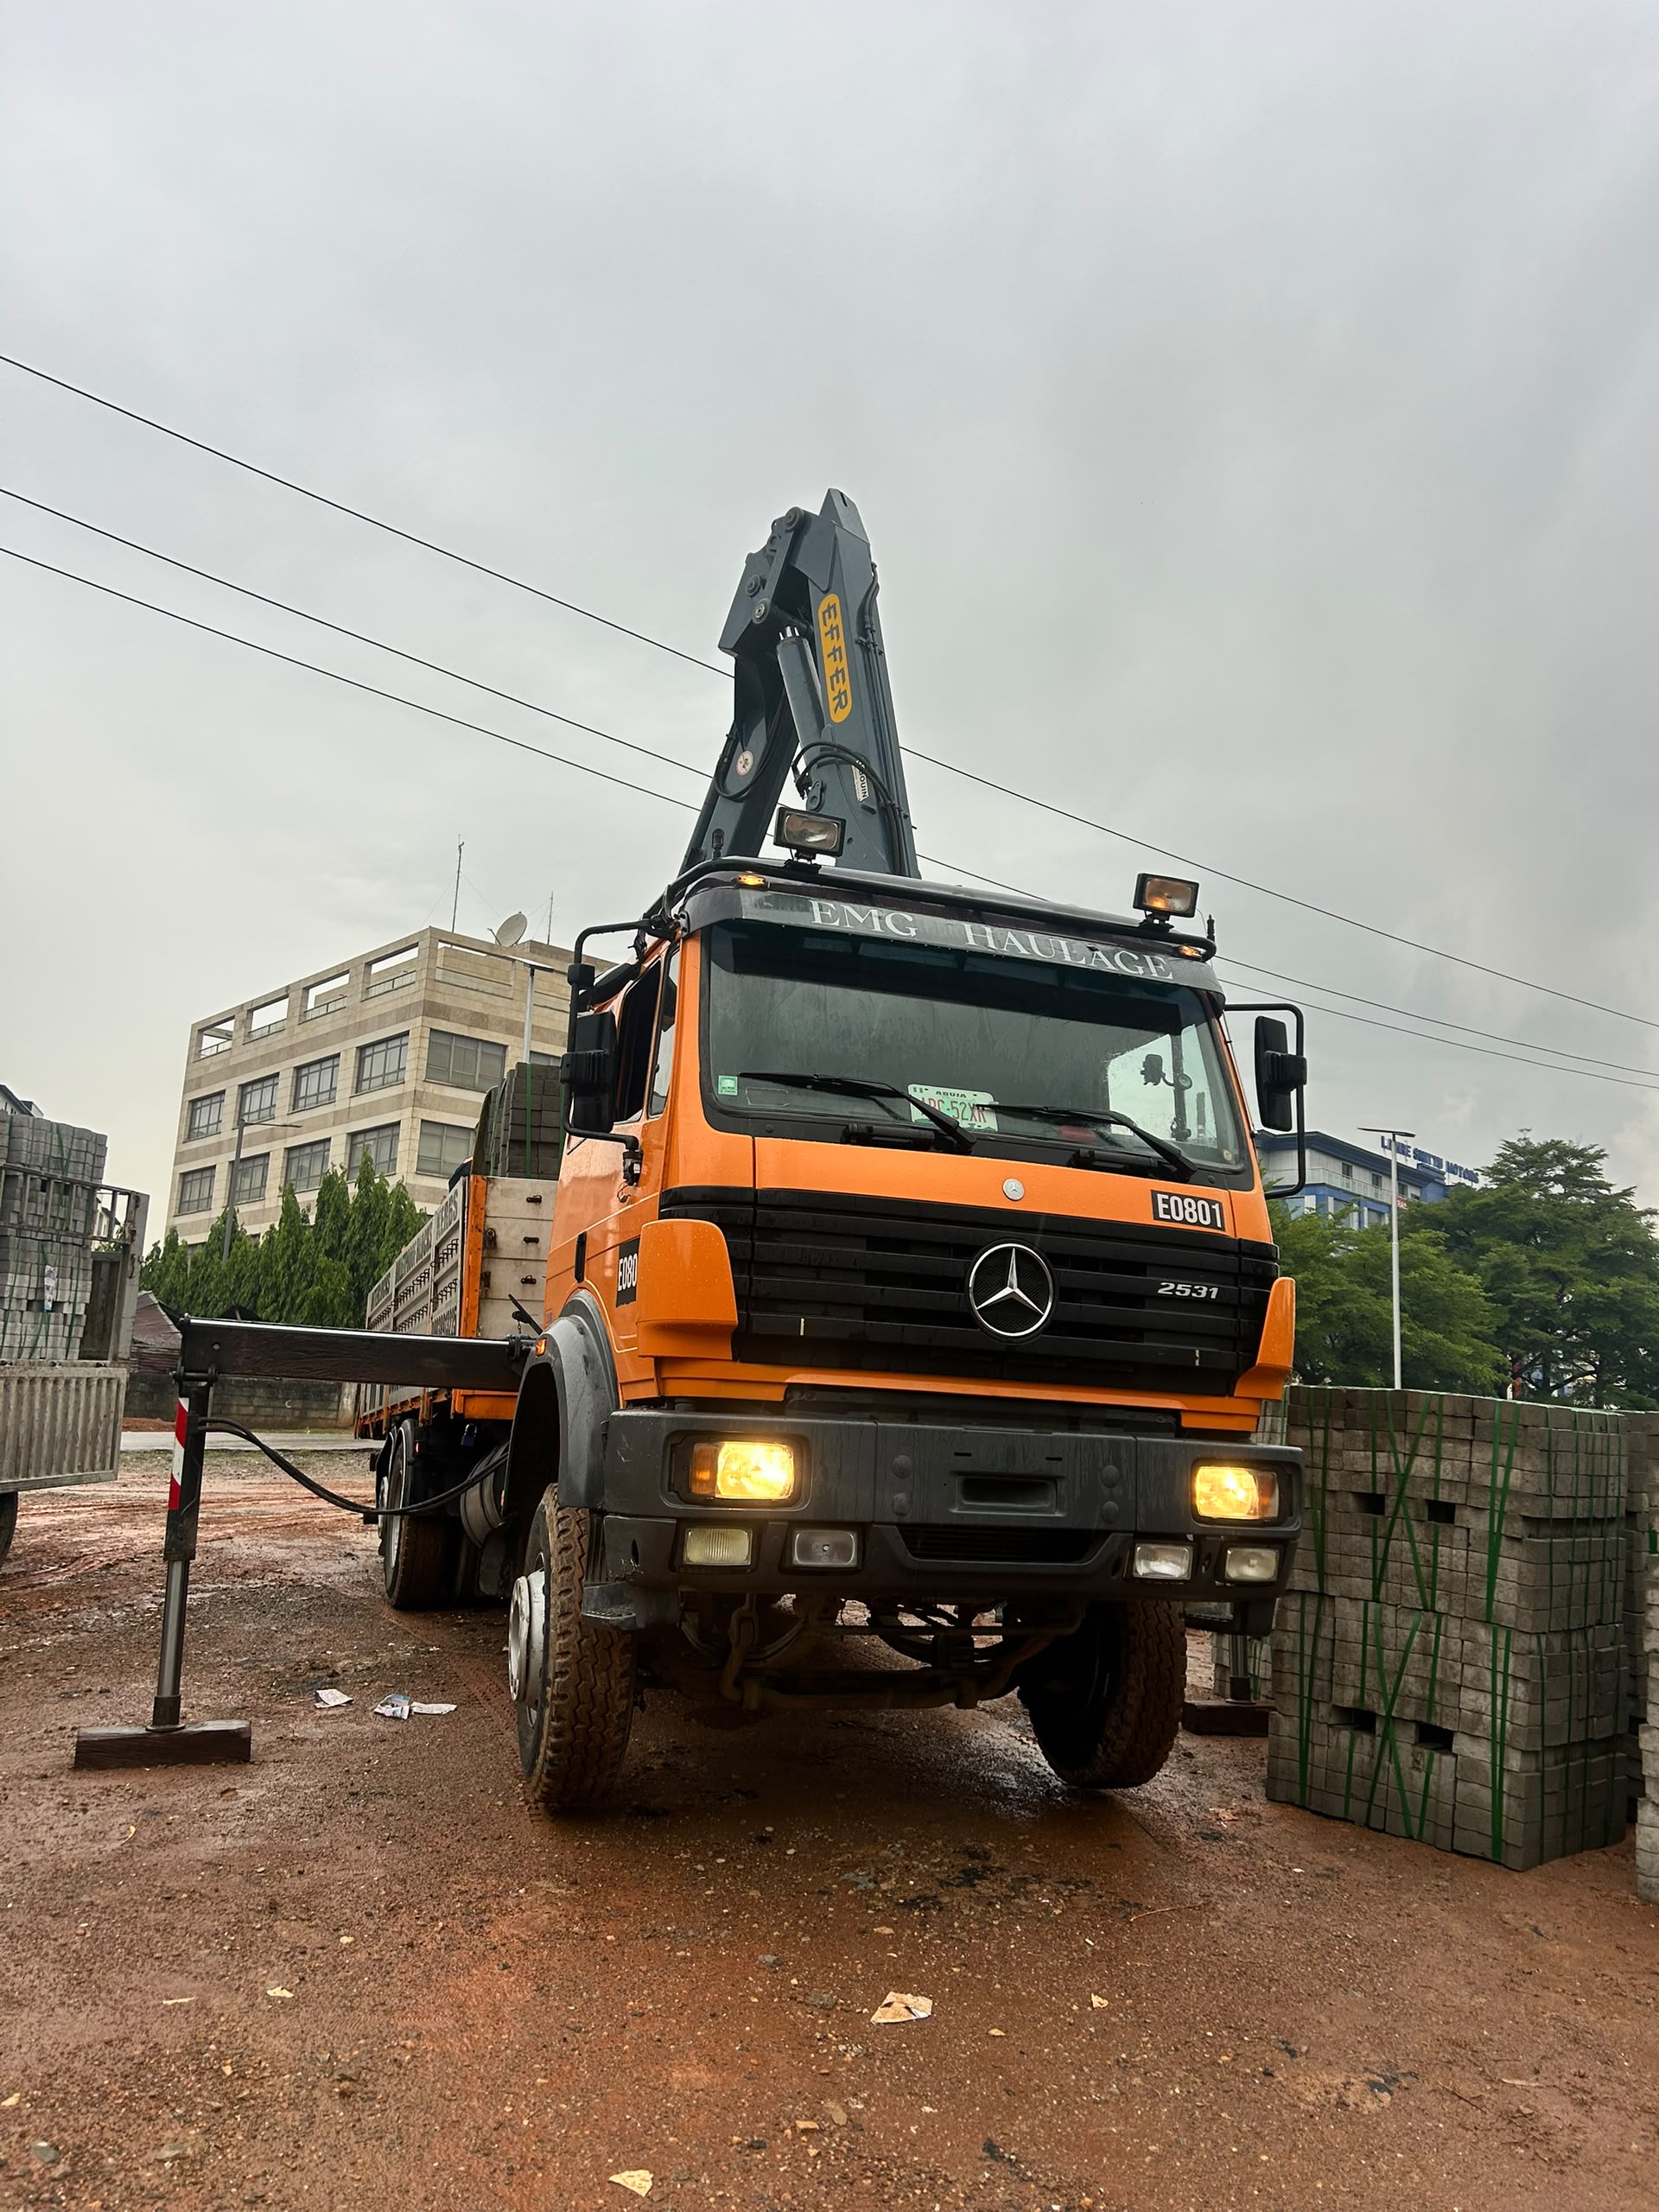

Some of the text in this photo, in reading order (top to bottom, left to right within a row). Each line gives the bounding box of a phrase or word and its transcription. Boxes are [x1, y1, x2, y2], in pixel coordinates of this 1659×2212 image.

[823, 601, 849, 715] EFFER
[808, 899, 1173, 980] EMG HAULAGE
[1157, 1193, 1223, 1228] E0801
[1157, 1281, 1219, 1299] 2531
